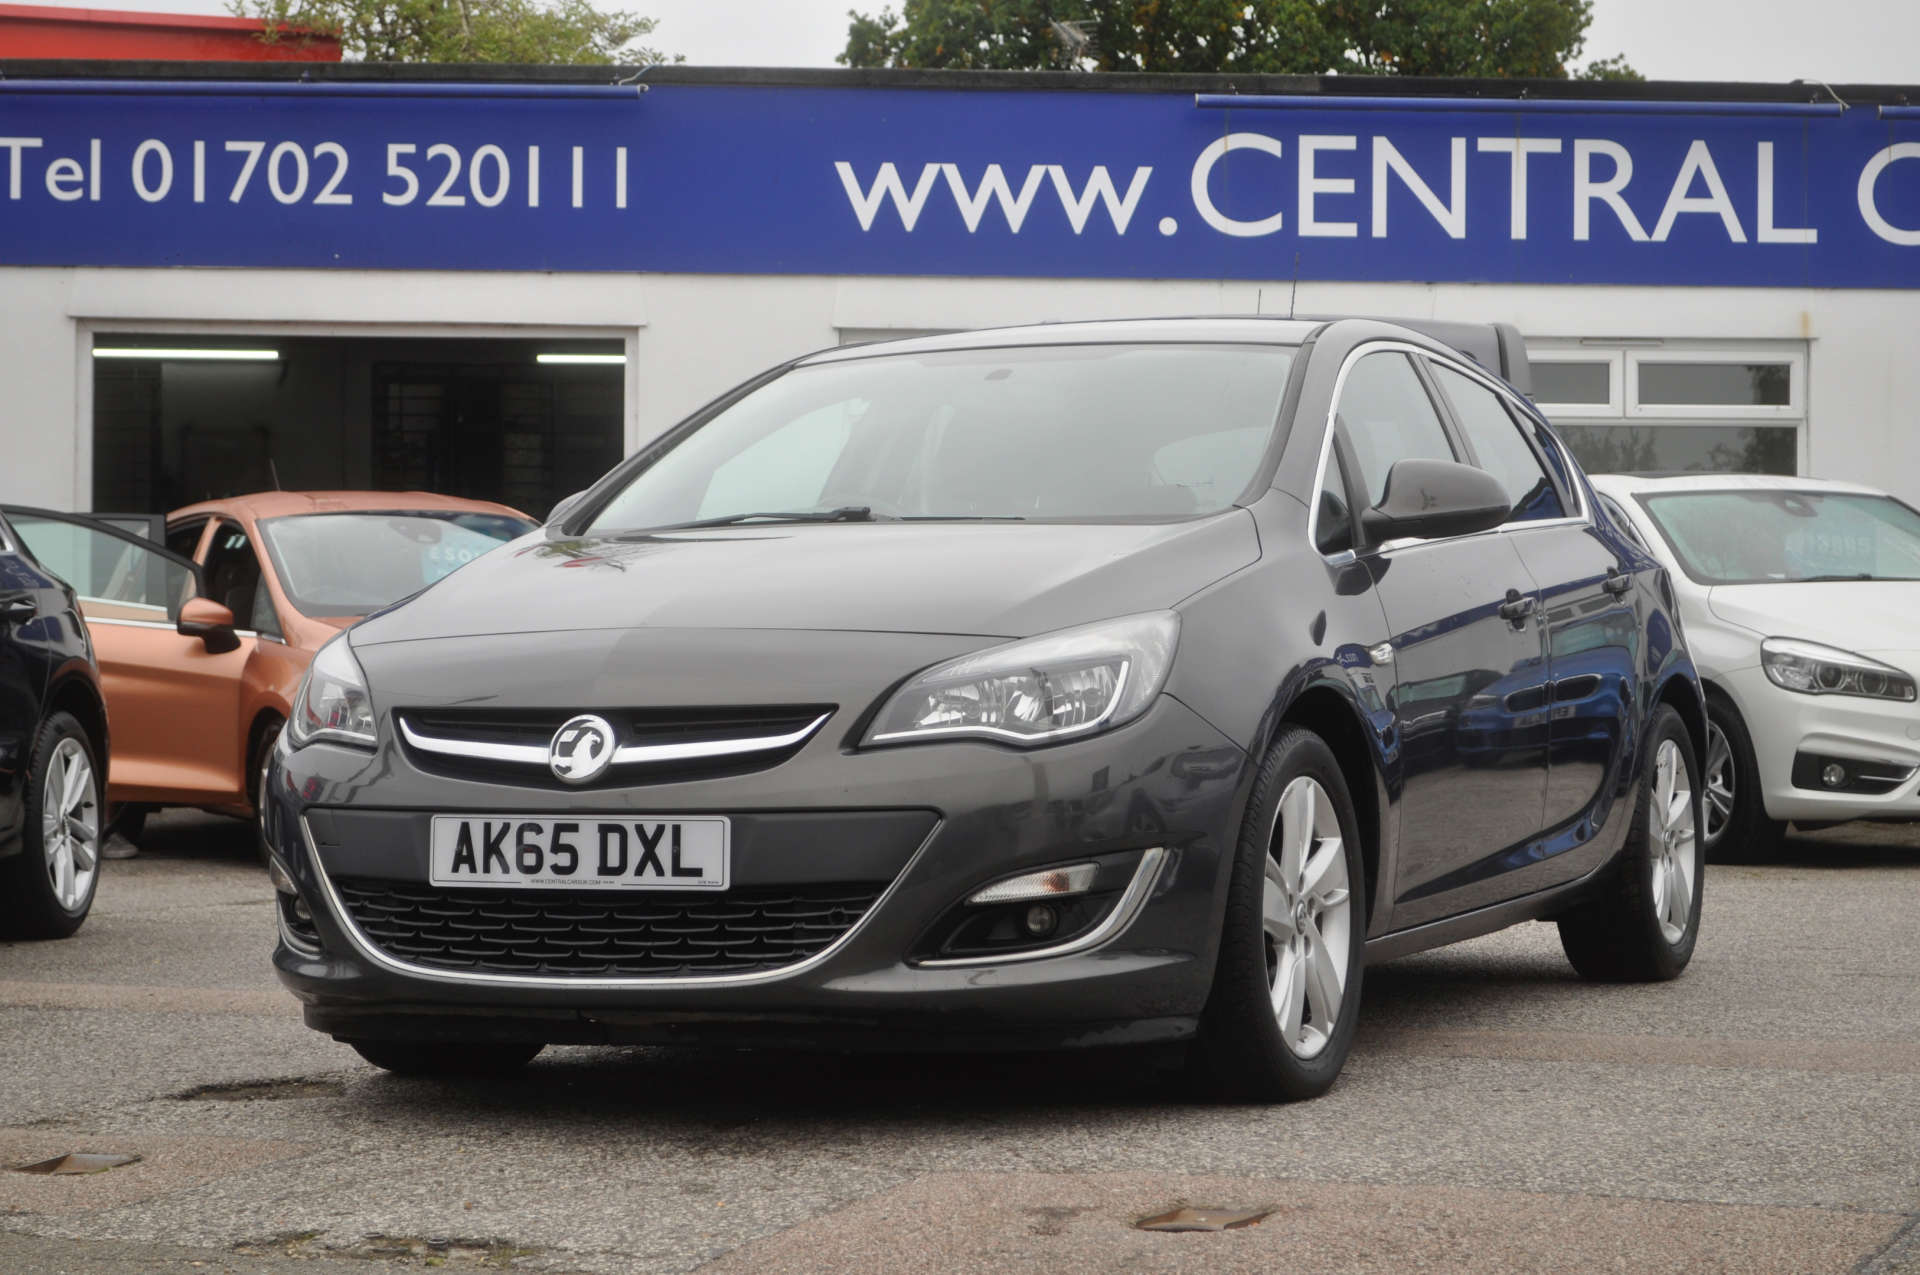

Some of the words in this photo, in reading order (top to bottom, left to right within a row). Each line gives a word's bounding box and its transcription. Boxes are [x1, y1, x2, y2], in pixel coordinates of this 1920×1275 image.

[0, 138, 101, 201] Tel
[132, 139, 353, 206] 01702
[382, 143, 627, 209] 520111
[451, 821, 580, 876] AK65
[597, 823, 703, 878] DXL
